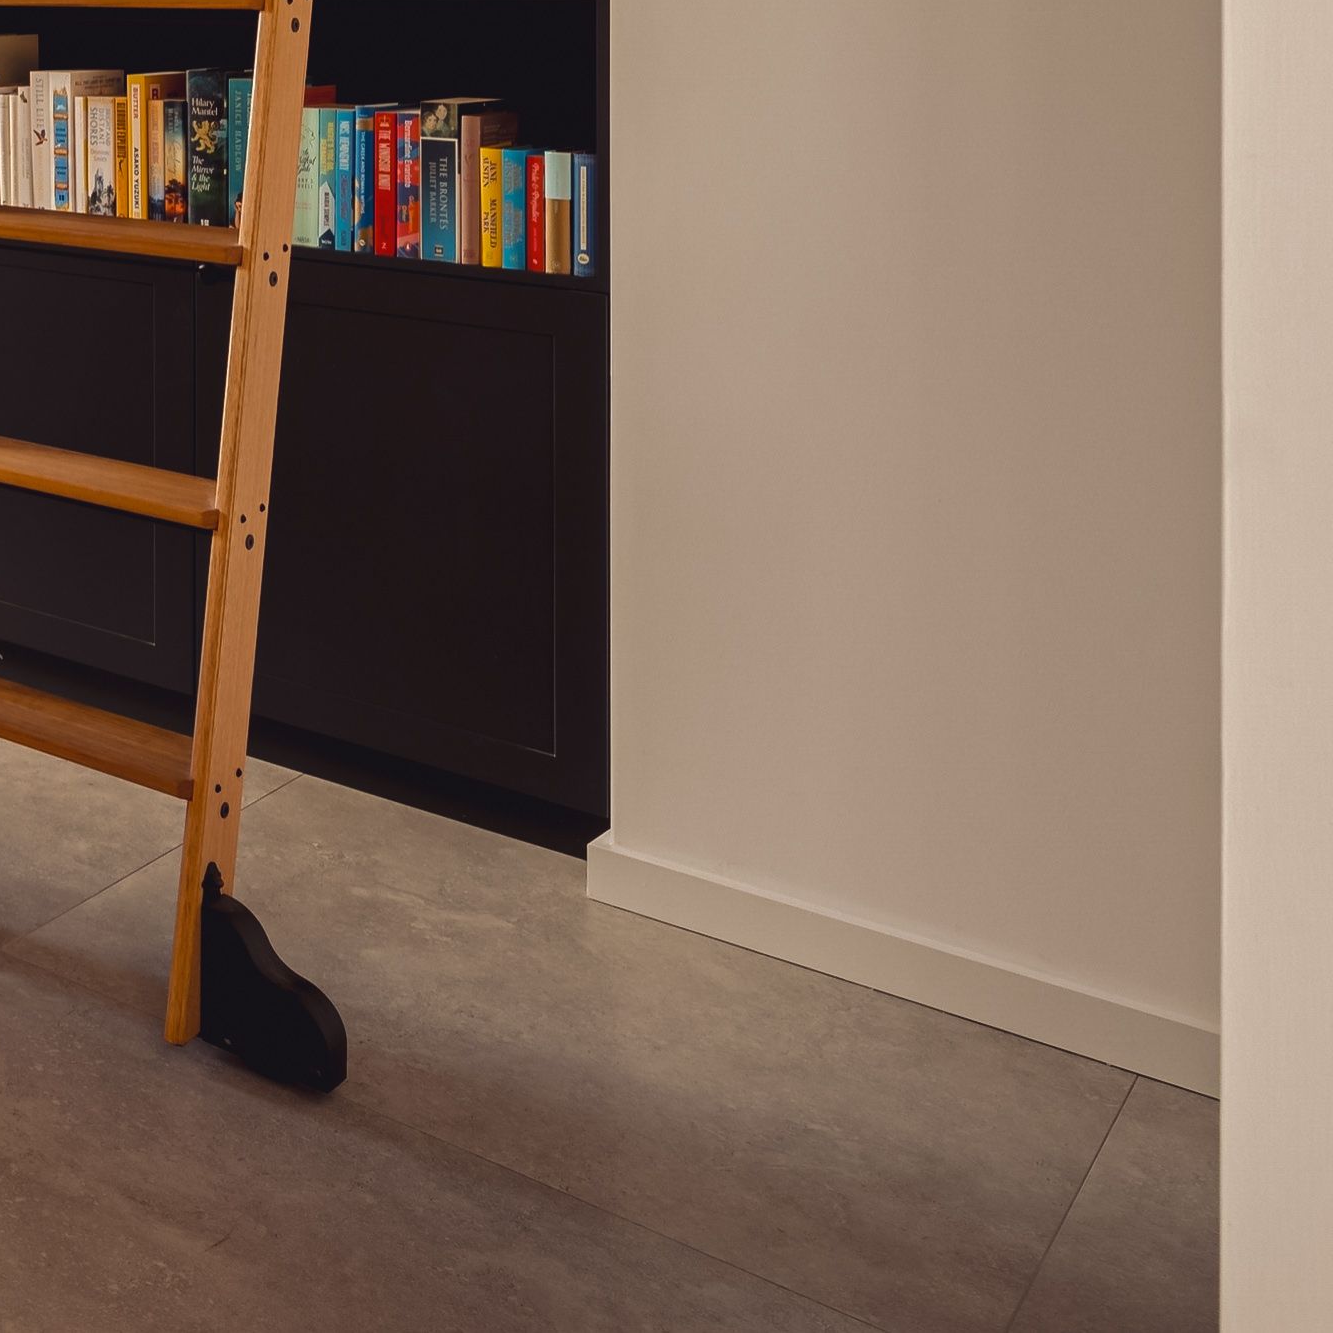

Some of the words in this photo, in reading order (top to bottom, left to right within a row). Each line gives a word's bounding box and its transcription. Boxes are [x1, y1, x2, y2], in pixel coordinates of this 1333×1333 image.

[35, 77, 44, 105] STILL
[191, 97, 215, 109] Hilary
[36, 108, 44, 129] LIFE
[190, 106, 220, 117] Mantel
[90, 107, 98, 146] SHORES
[378, 129, 391, 142] THE
[404, 120, 412, 158] Bernardine
[117, 131, 126, 159] EXPLOITS
[378, 142, 390, 172] WINDSOR
[191, 164, 215, 175] Mirror
[192, 156, 205, 165] The
[439, 157, 447, 179] THE
[482, 156, 490, 187] AUSTEN
[531, 162, 540, 183] Pride
[199, 173, 212, 183] the
[378, 173, 391, 191] KNOT
[404, 159, 412, 188] Evaristo
[428, 161, 436, 189] JULIET
[191, 181, 211, 193] Light
[429, 191, 437, 224] BARKER
[531, 192, 540, 223] Prejudice
[490, 198, 498, 249] MANSFIELD
